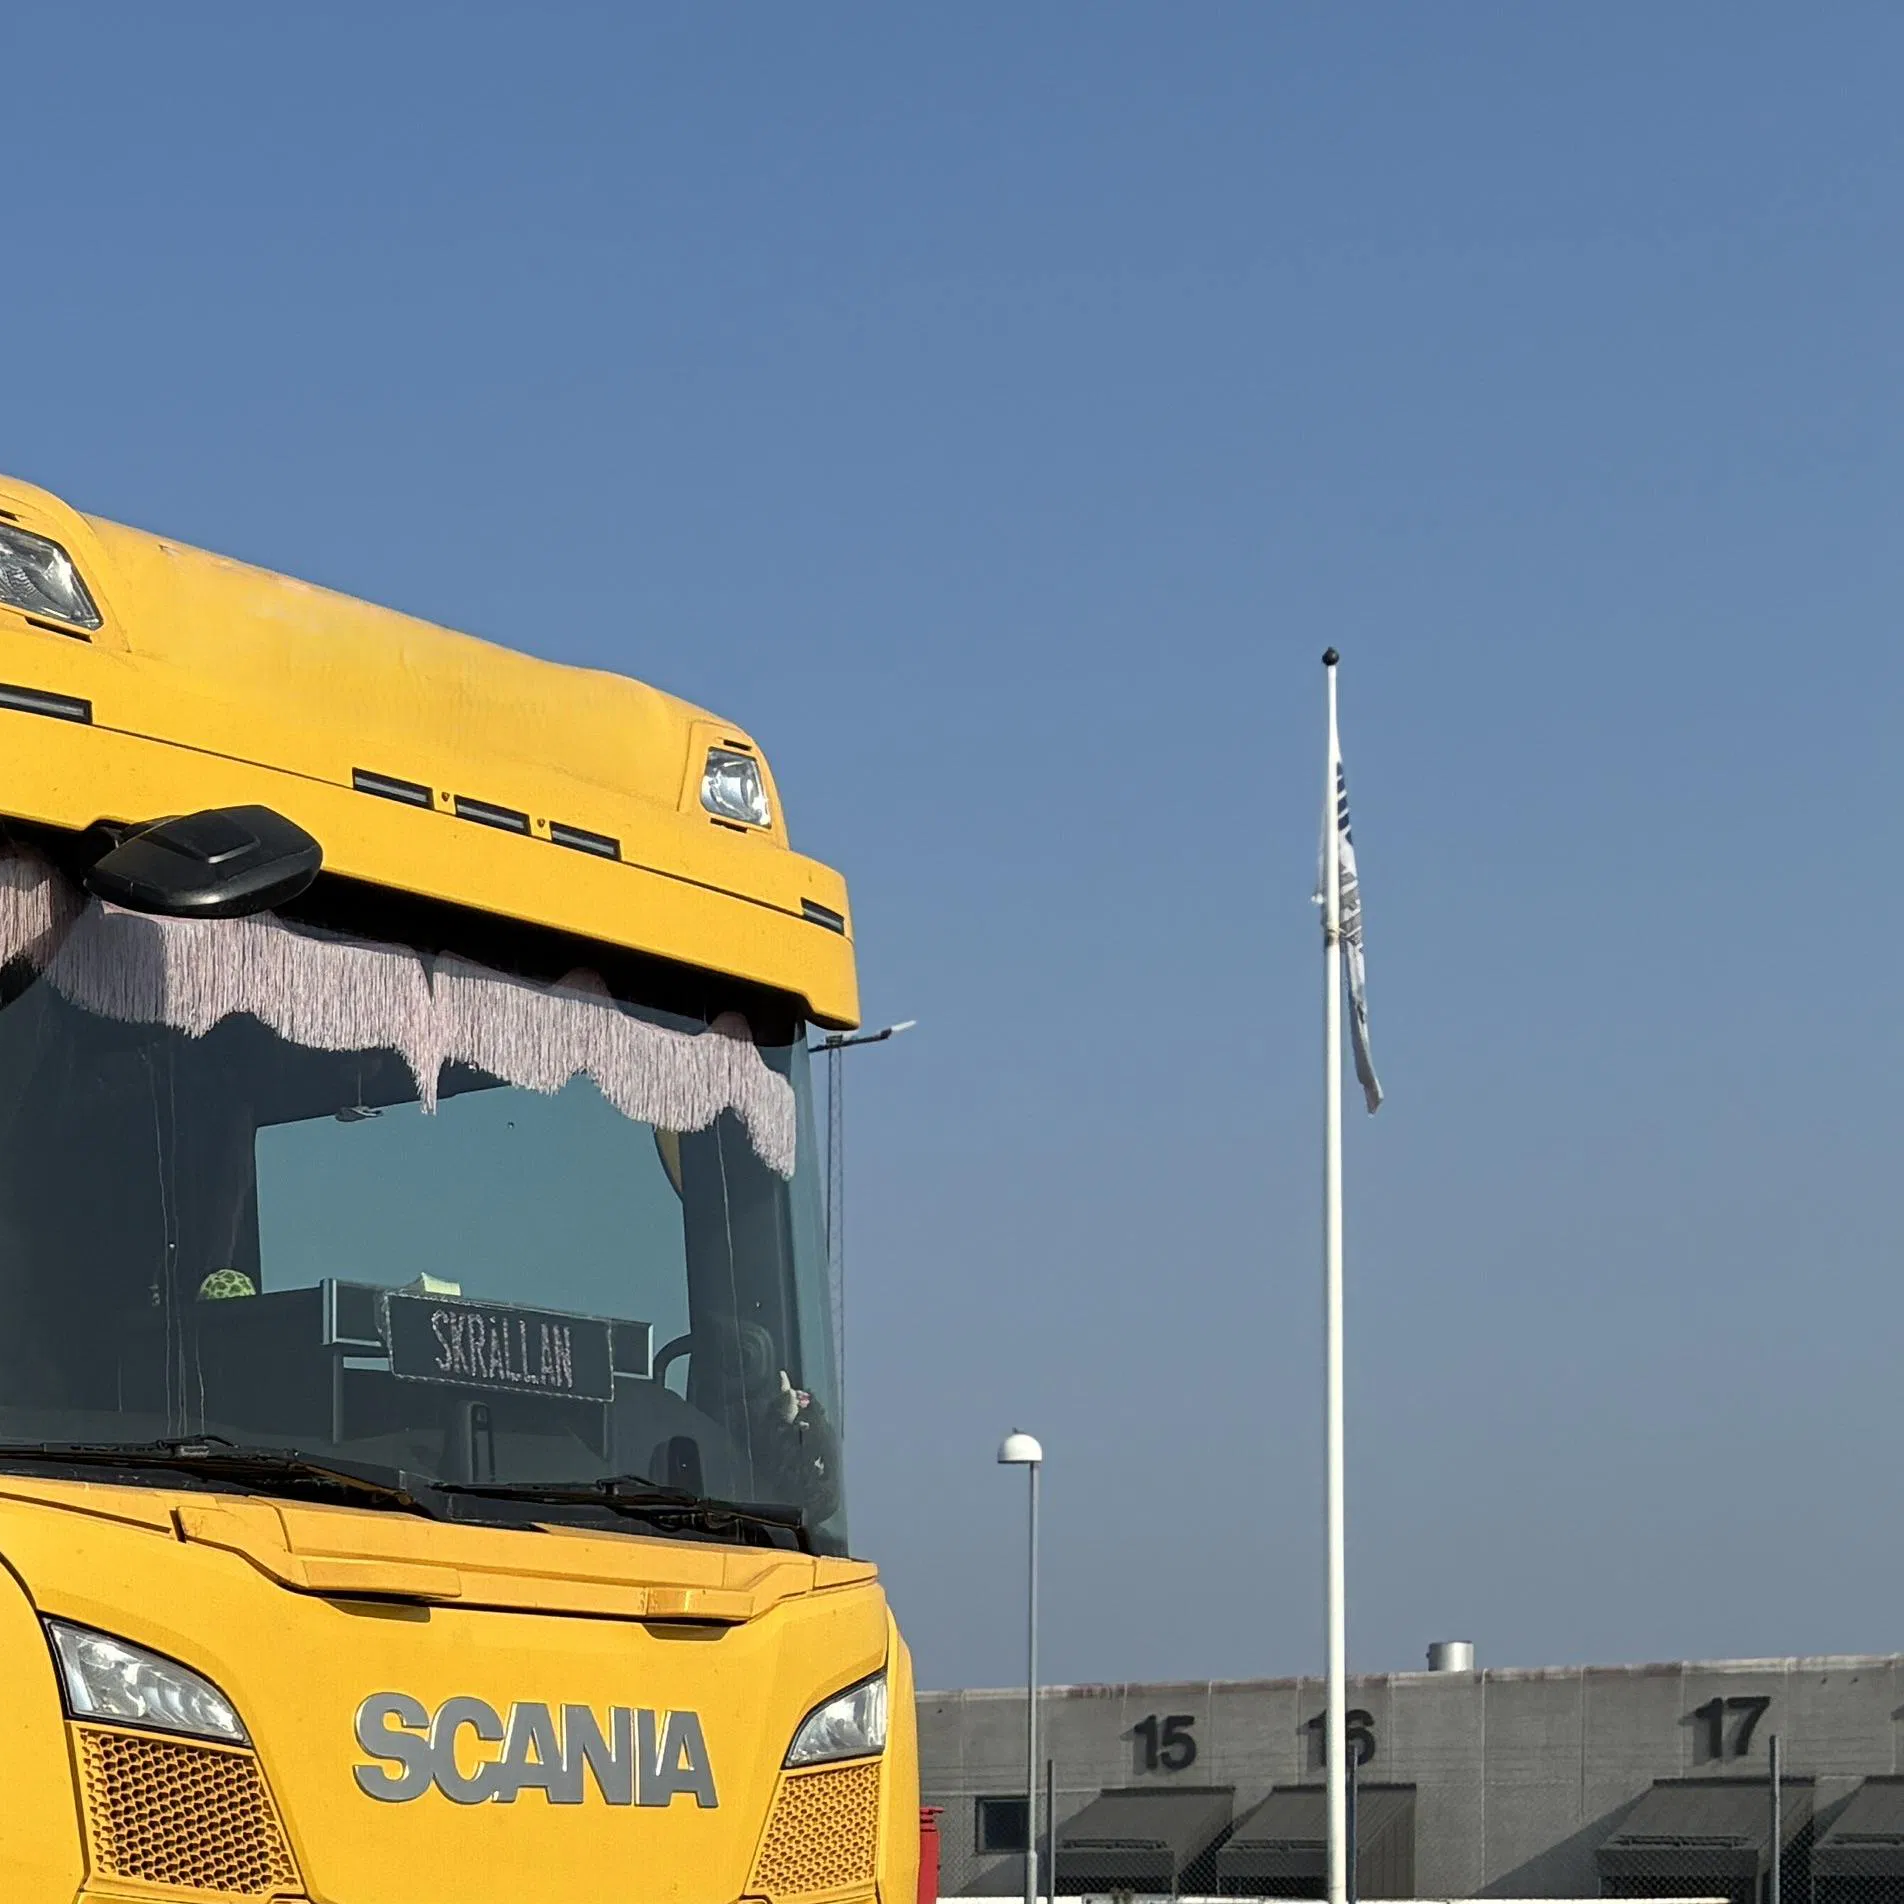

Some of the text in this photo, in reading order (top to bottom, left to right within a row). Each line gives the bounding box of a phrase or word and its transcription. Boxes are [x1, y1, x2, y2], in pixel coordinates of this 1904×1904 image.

[352, 1691, 719, 1808] SCANIA
[1133, 1713, 1197, 1770] 15
[1308, 1708, 1375, 1768] 16
[1695, 1696, 1771, 1759] 17
